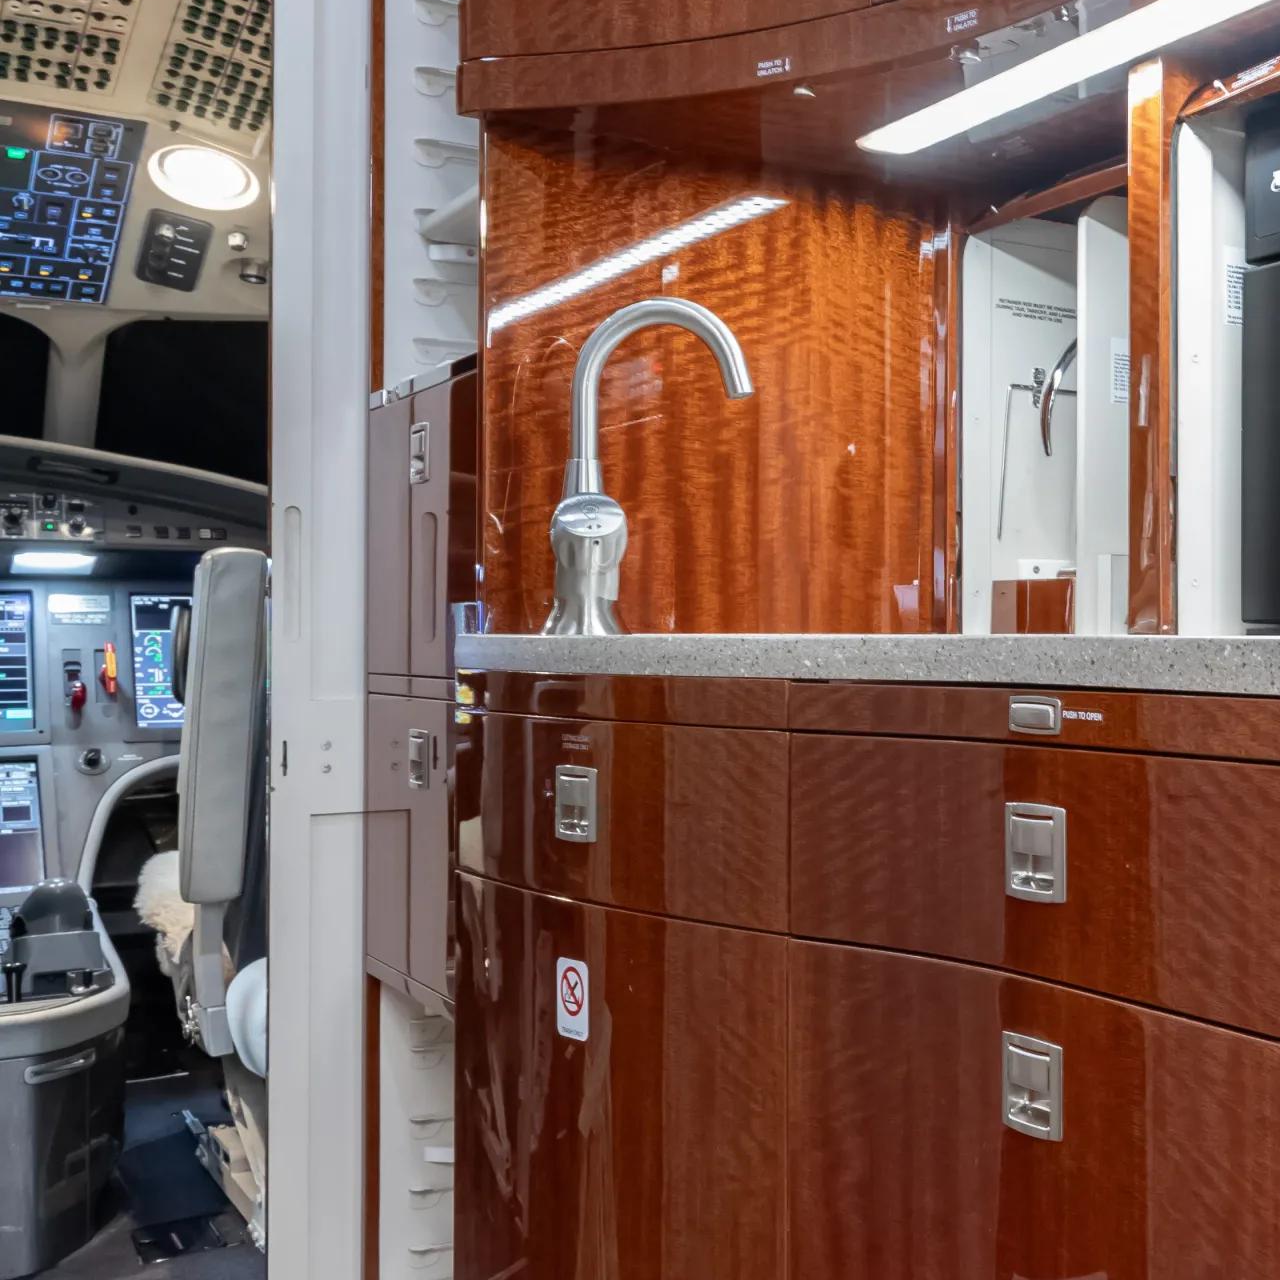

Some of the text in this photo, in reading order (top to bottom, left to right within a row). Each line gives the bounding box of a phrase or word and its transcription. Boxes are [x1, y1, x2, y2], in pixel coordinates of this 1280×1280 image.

[953, 10, 977, 23] PUSH TO
[757, 61, 773, 69] PUSH
[1062, 710, 1102, 721] PUSH TO OPEN
